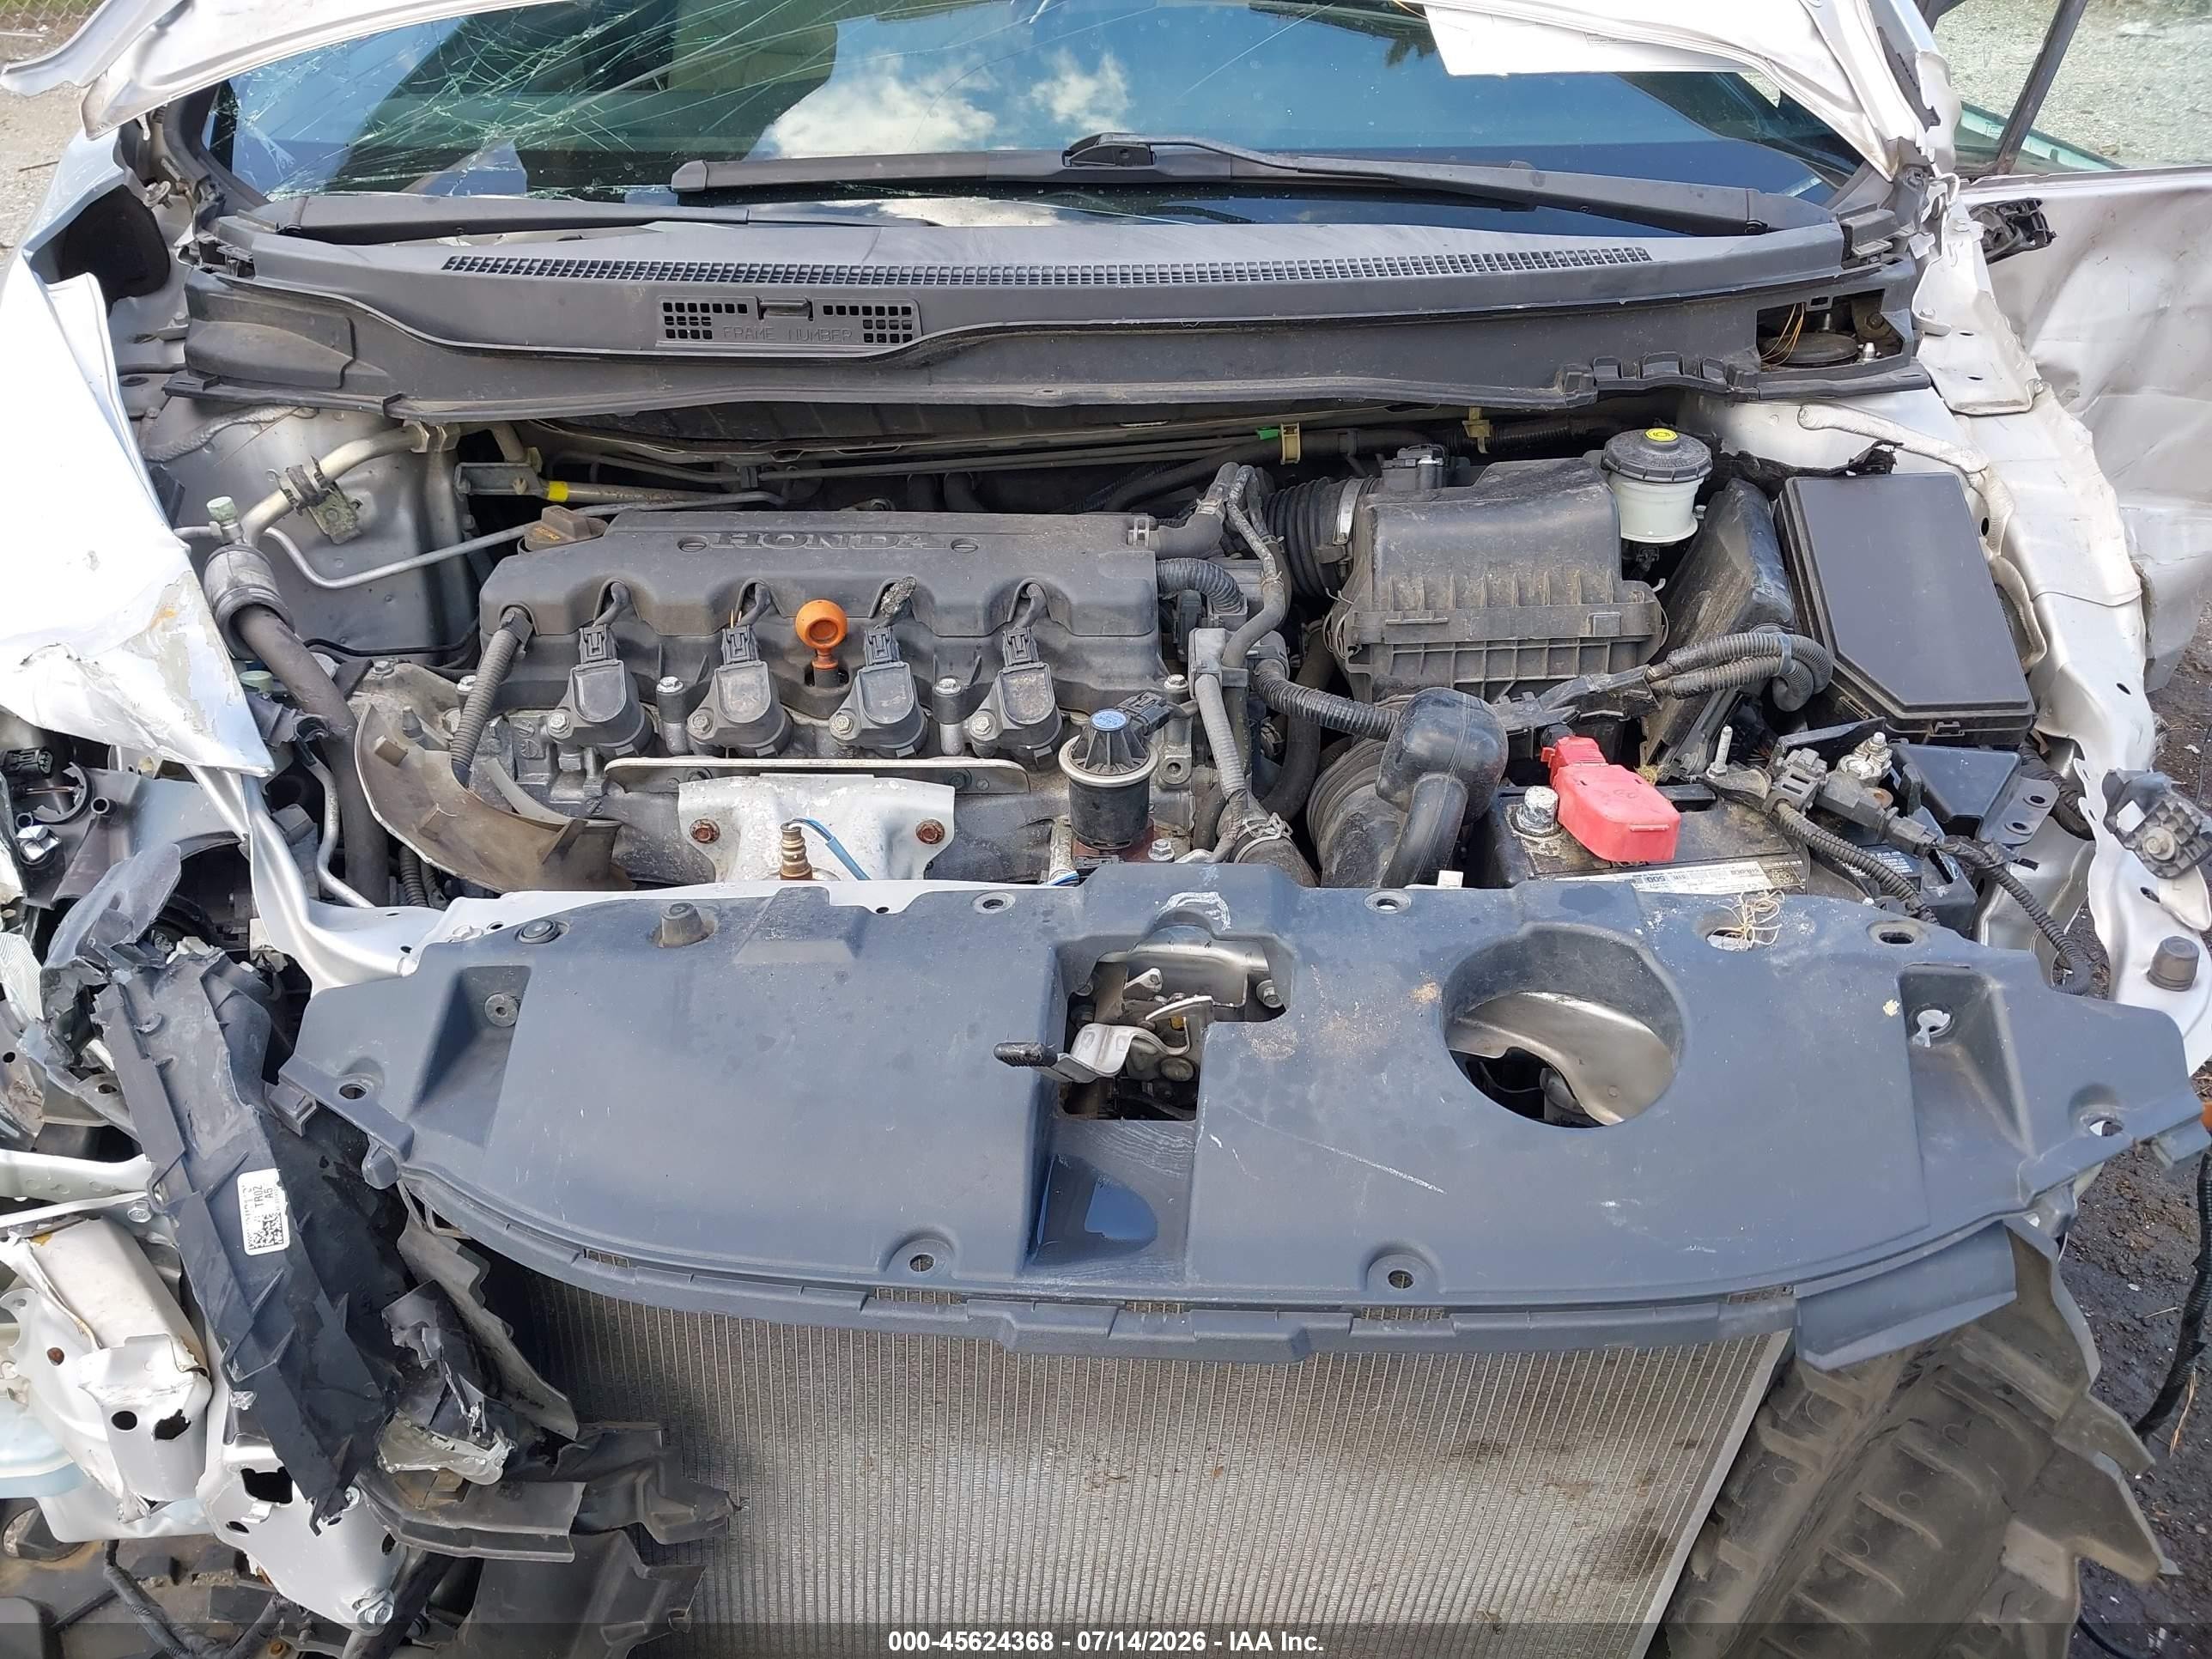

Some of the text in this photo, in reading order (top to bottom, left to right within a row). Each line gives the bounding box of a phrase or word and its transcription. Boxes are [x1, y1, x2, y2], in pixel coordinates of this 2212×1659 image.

[723, 326, 853, 342] FRAME NUMBER
[711, 532, 946, 550] HONDA
